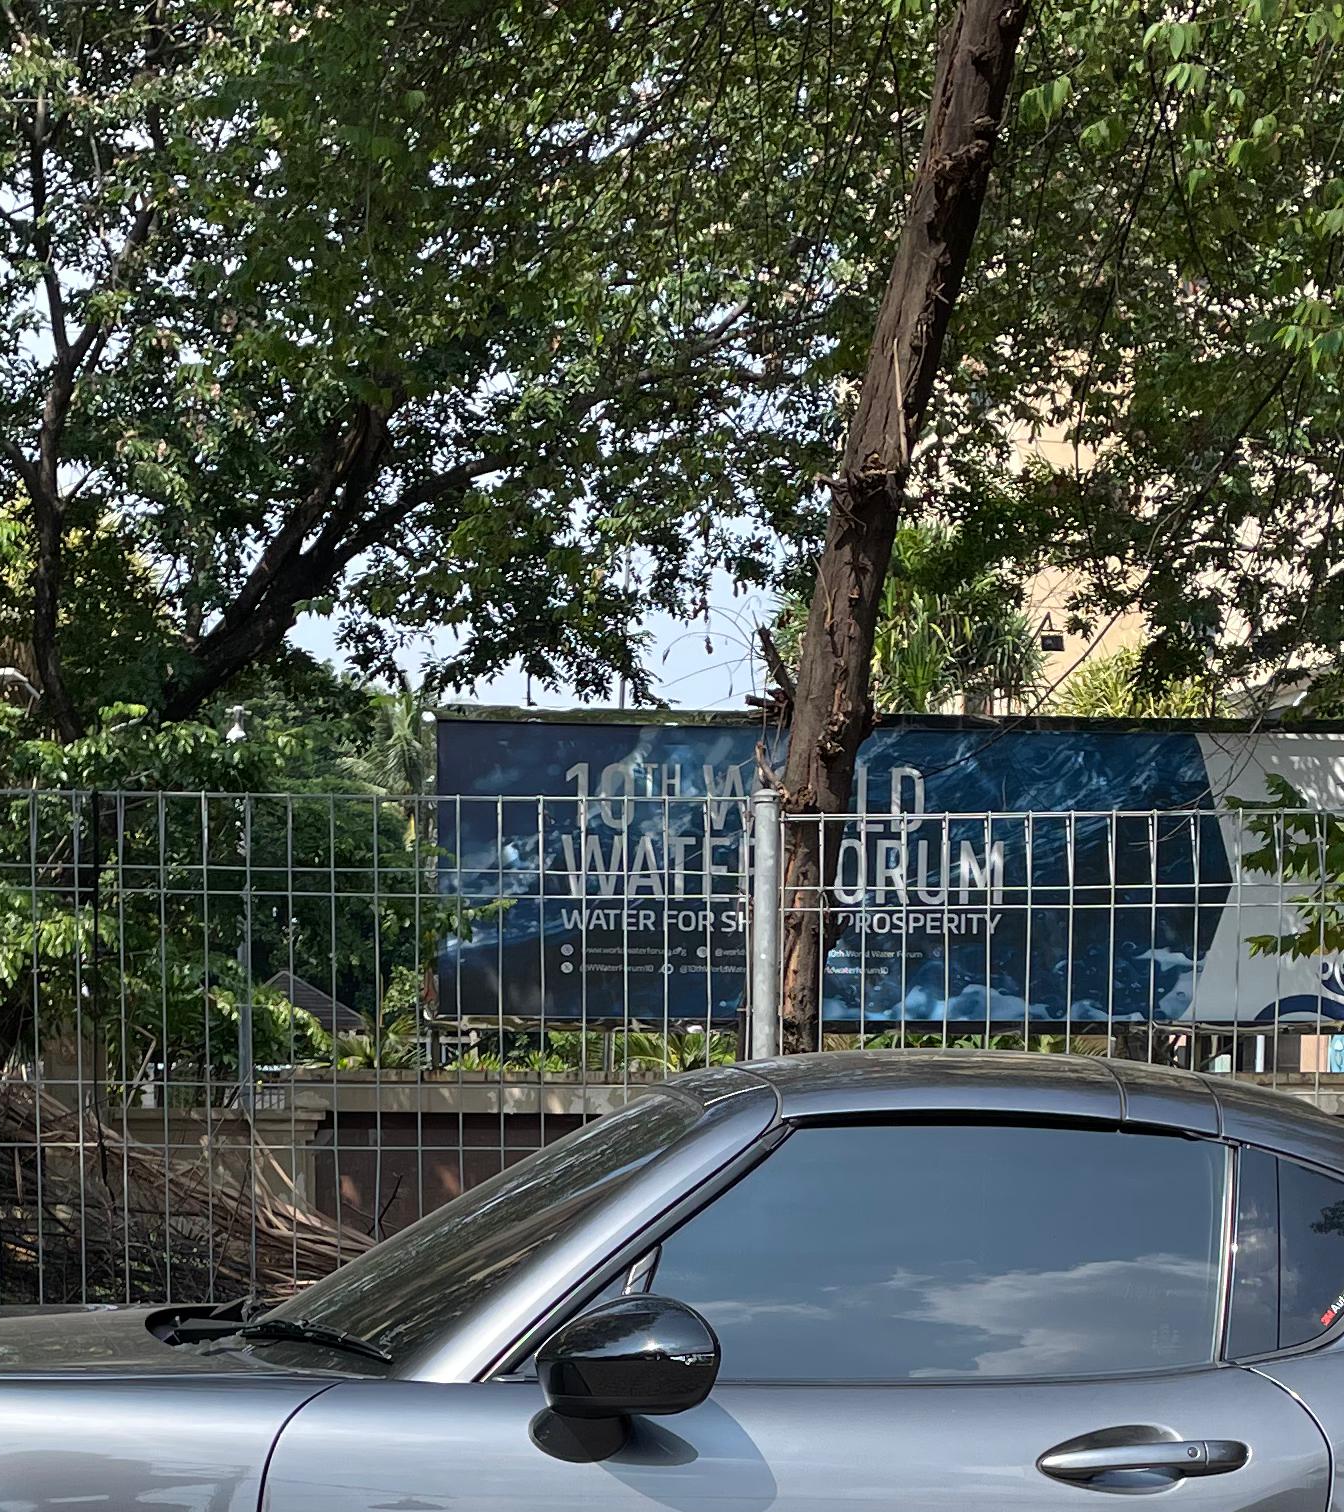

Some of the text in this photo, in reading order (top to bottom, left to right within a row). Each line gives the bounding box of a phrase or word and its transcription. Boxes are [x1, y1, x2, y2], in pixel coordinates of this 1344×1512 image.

[834, 838, 1004, 904] ORUM
[562, 908, 655, 931] WATER
[665, 911, 714, 932] FOR
